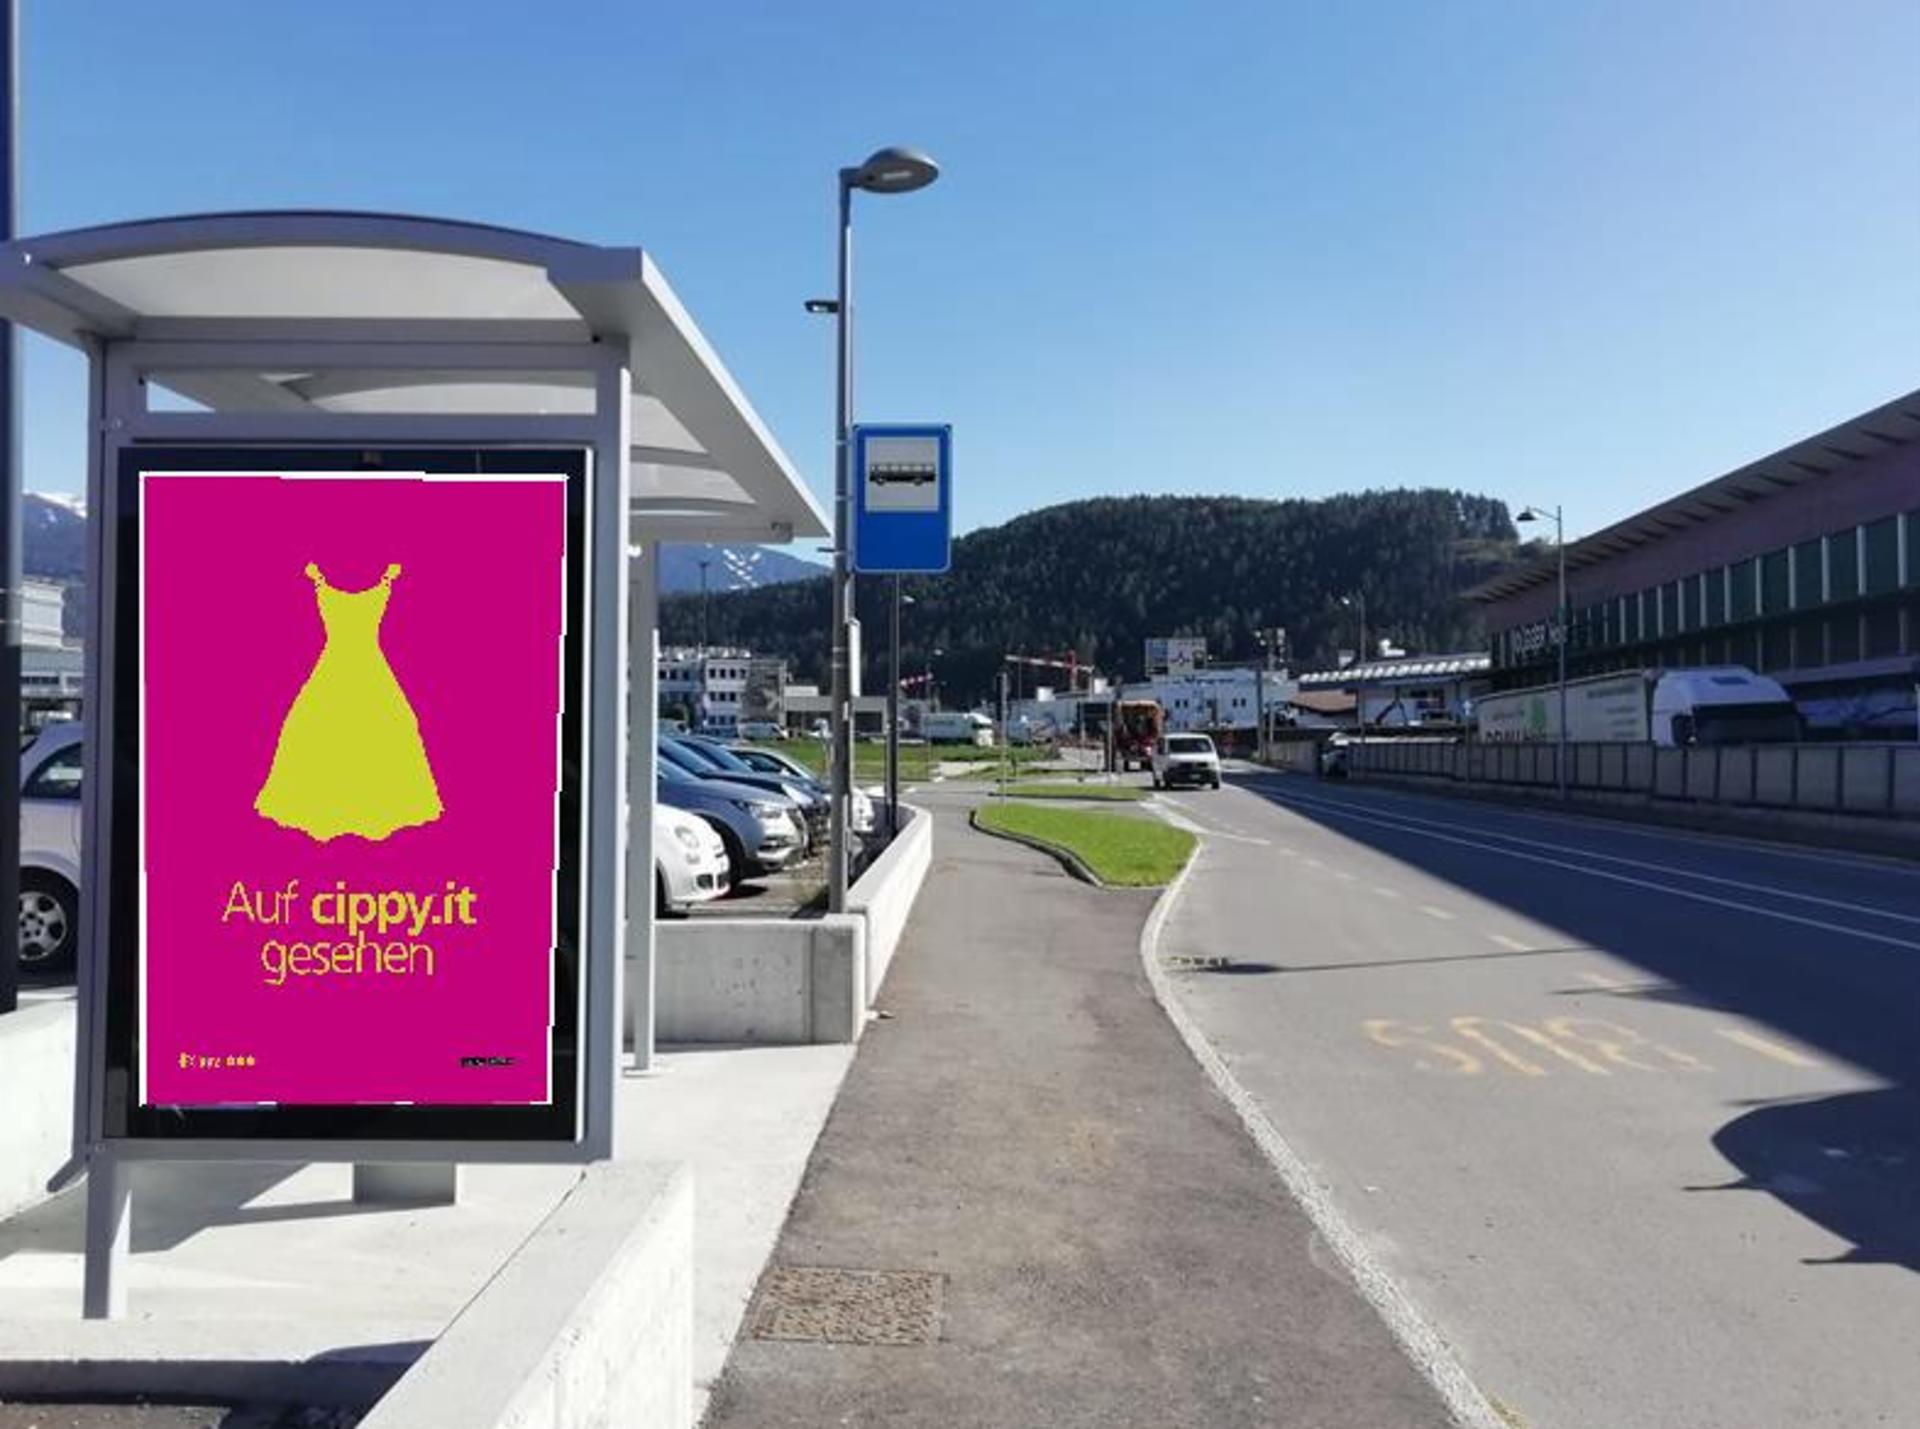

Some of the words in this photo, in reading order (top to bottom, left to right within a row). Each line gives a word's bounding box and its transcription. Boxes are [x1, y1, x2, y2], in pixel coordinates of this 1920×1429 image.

[222, 879, 298, 923] Auf
[311, 881, 477, 936] cippy.it
[261, 930, 434, 985] gesehen
